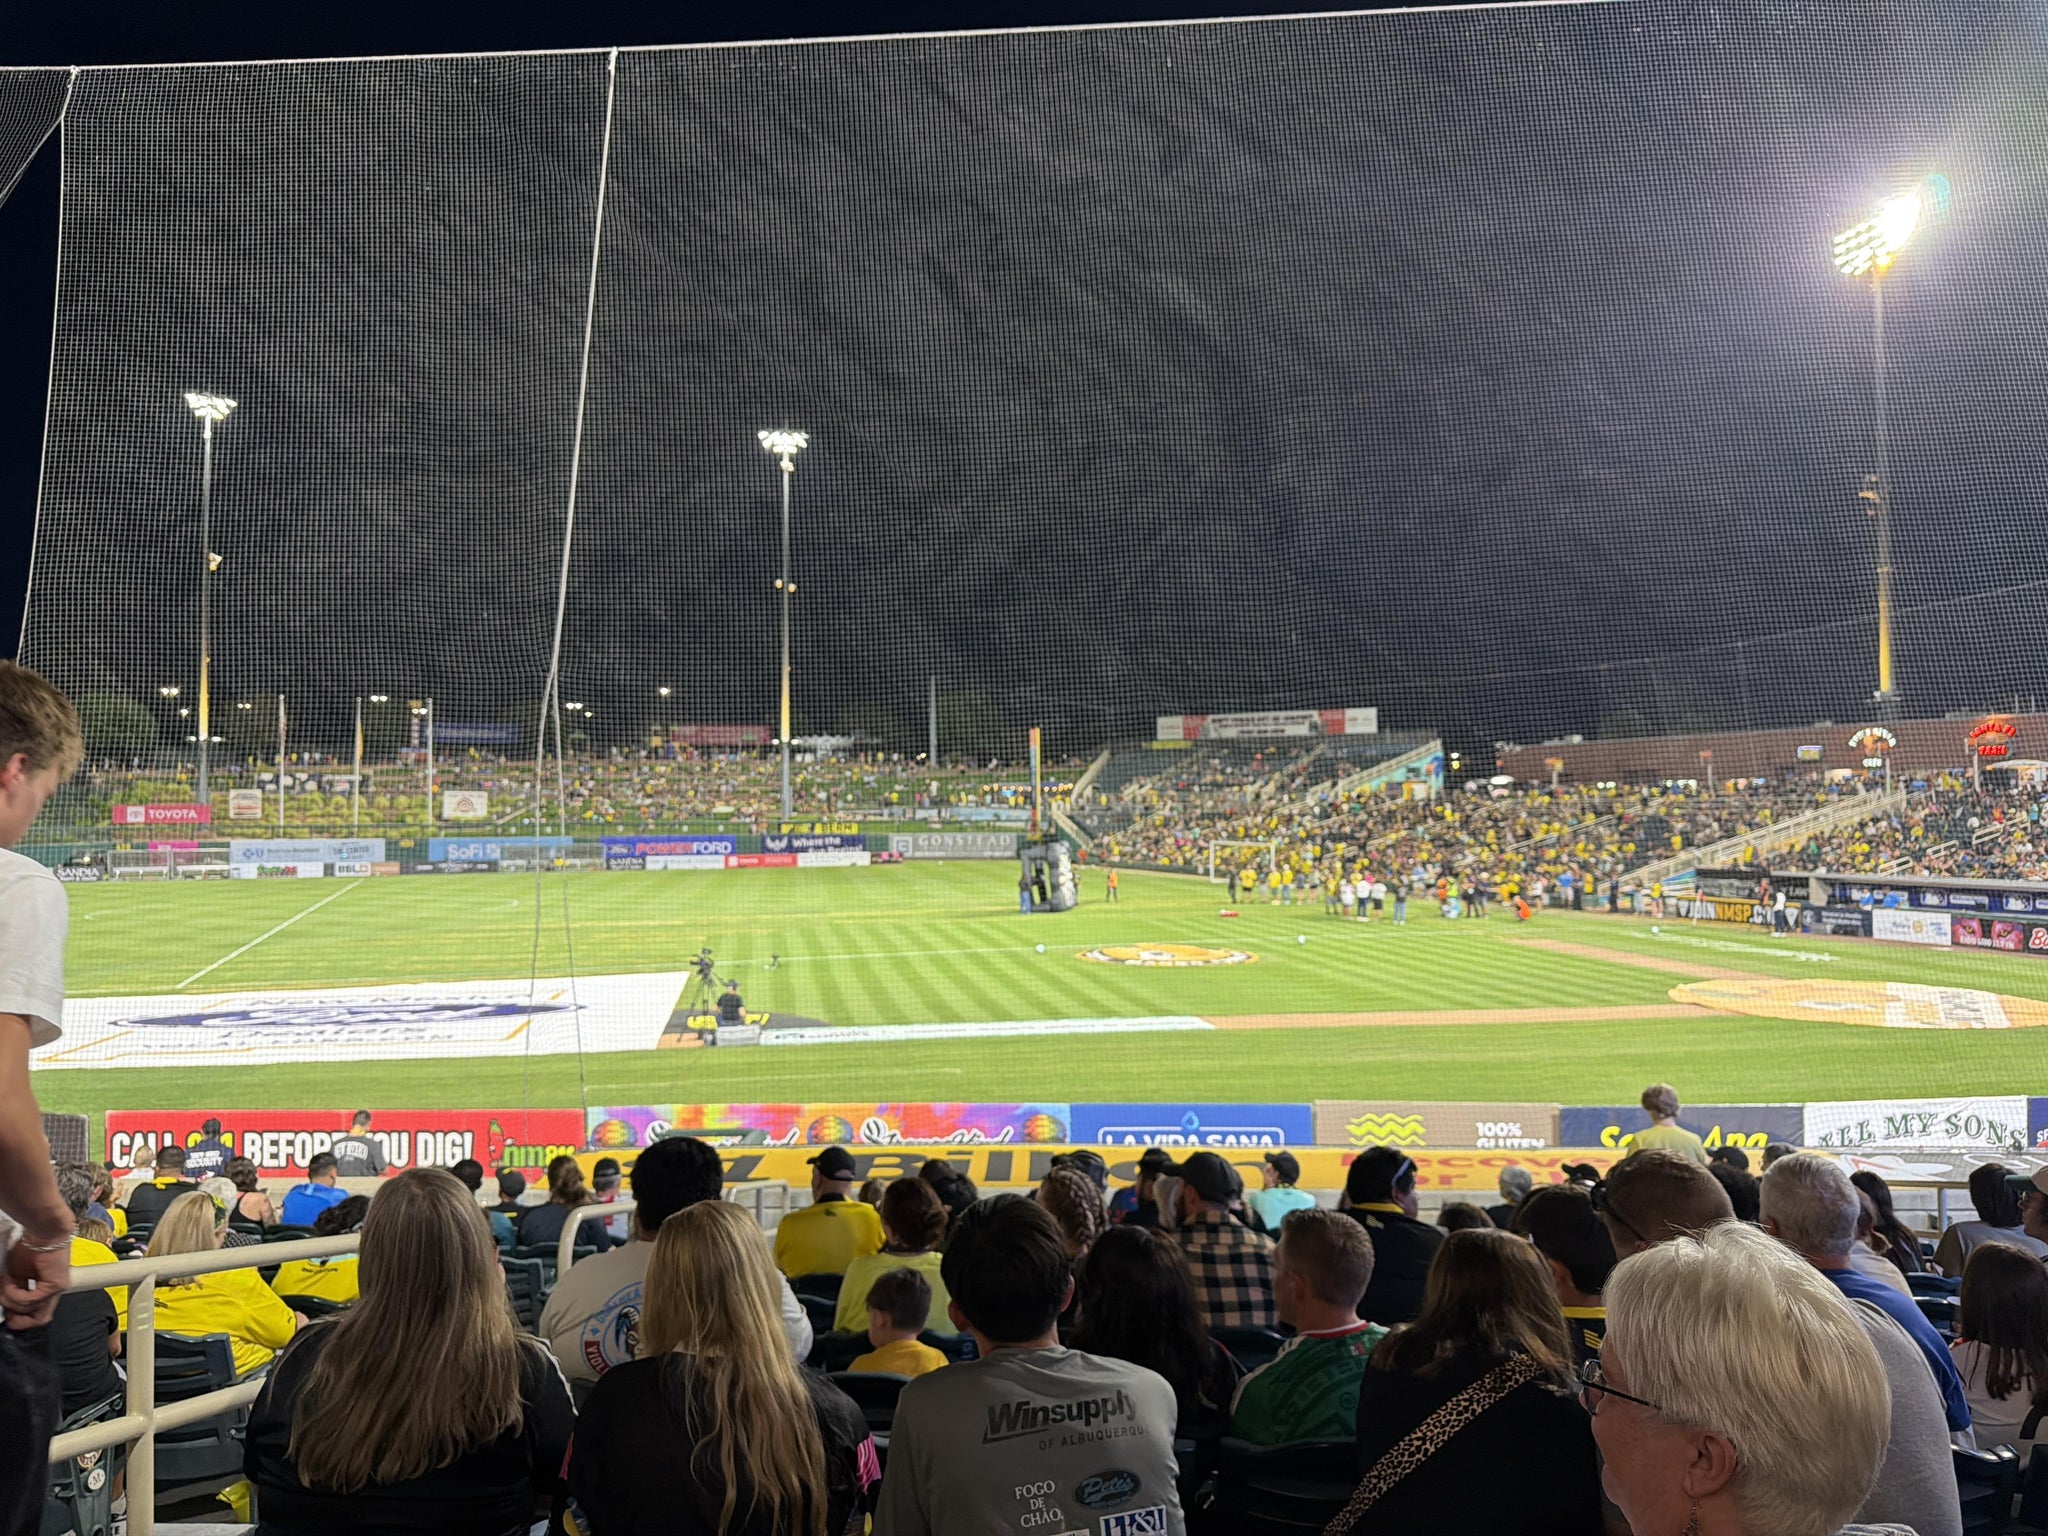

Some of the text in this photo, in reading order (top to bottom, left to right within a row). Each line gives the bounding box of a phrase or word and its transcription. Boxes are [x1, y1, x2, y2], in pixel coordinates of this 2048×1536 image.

[148, 809, 198, 820] TOYOTA
[918, 834, 1010, 846] GONSTEAD
[447, 843, 483, 859] SoFi
[1475, 1121, 1523, 1138] 100%
[1885, 1112, 1939, 1138] MY
[1945, 1112, 2026, 1151] SONS
[415, 1131, 474, 1168] DIG!
[984, 1389, 1138, 1436] Winsupply
[1039, 1439, 1054, 1451] OF
[1014, 1479, 1056, 1500] FOGO
[1029, 1497, 1046, 1511] DE
